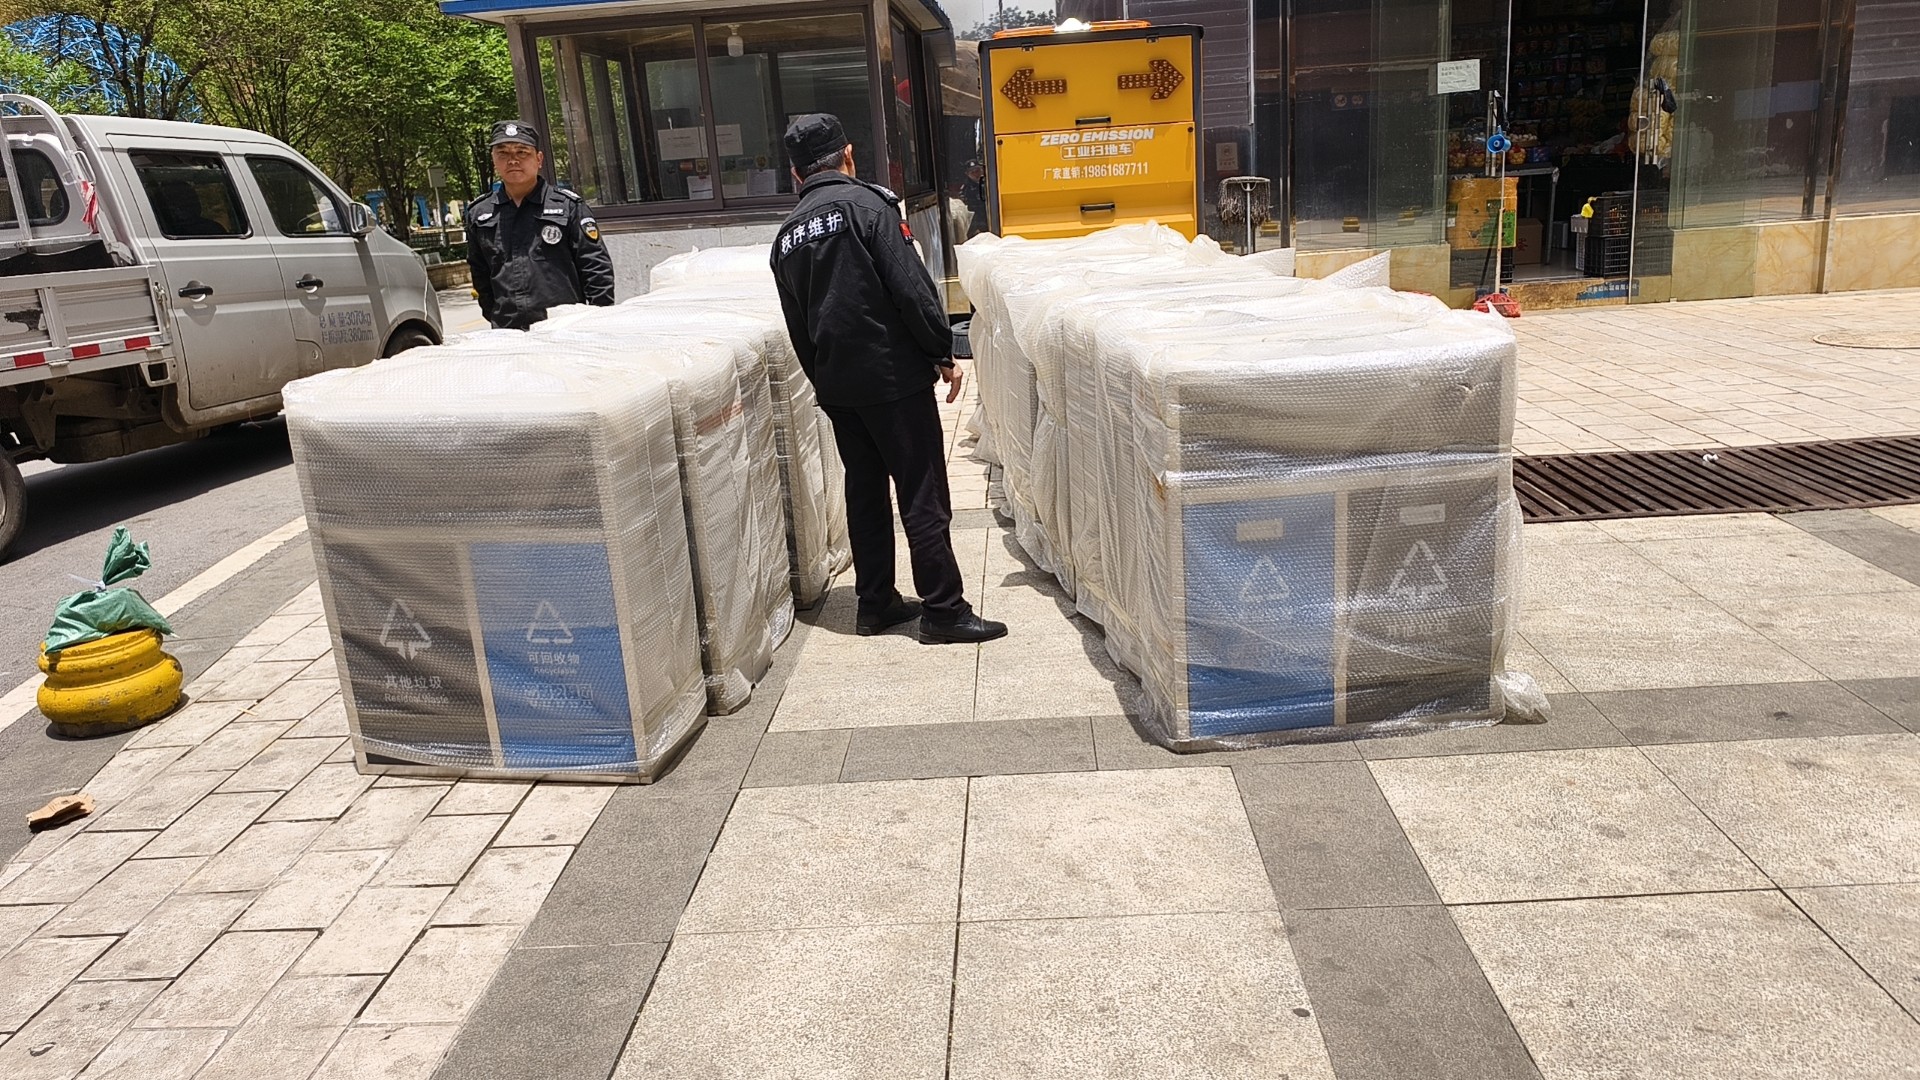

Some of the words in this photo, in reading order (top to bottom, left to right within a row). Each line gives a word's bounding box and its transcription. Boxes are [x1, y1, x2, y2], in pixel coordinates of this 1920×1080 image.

[1040, 133, 1080, 146] ZERO
[1082, 128, 1154, 142] EMISSION
[1063, 143, 1132, 158] 工业扫地车
[781, 210, 843, 254] 秩序维护
[527, 651, 580, 665] 可回收物
[384, 673, 443, 690] 其他垃圾
